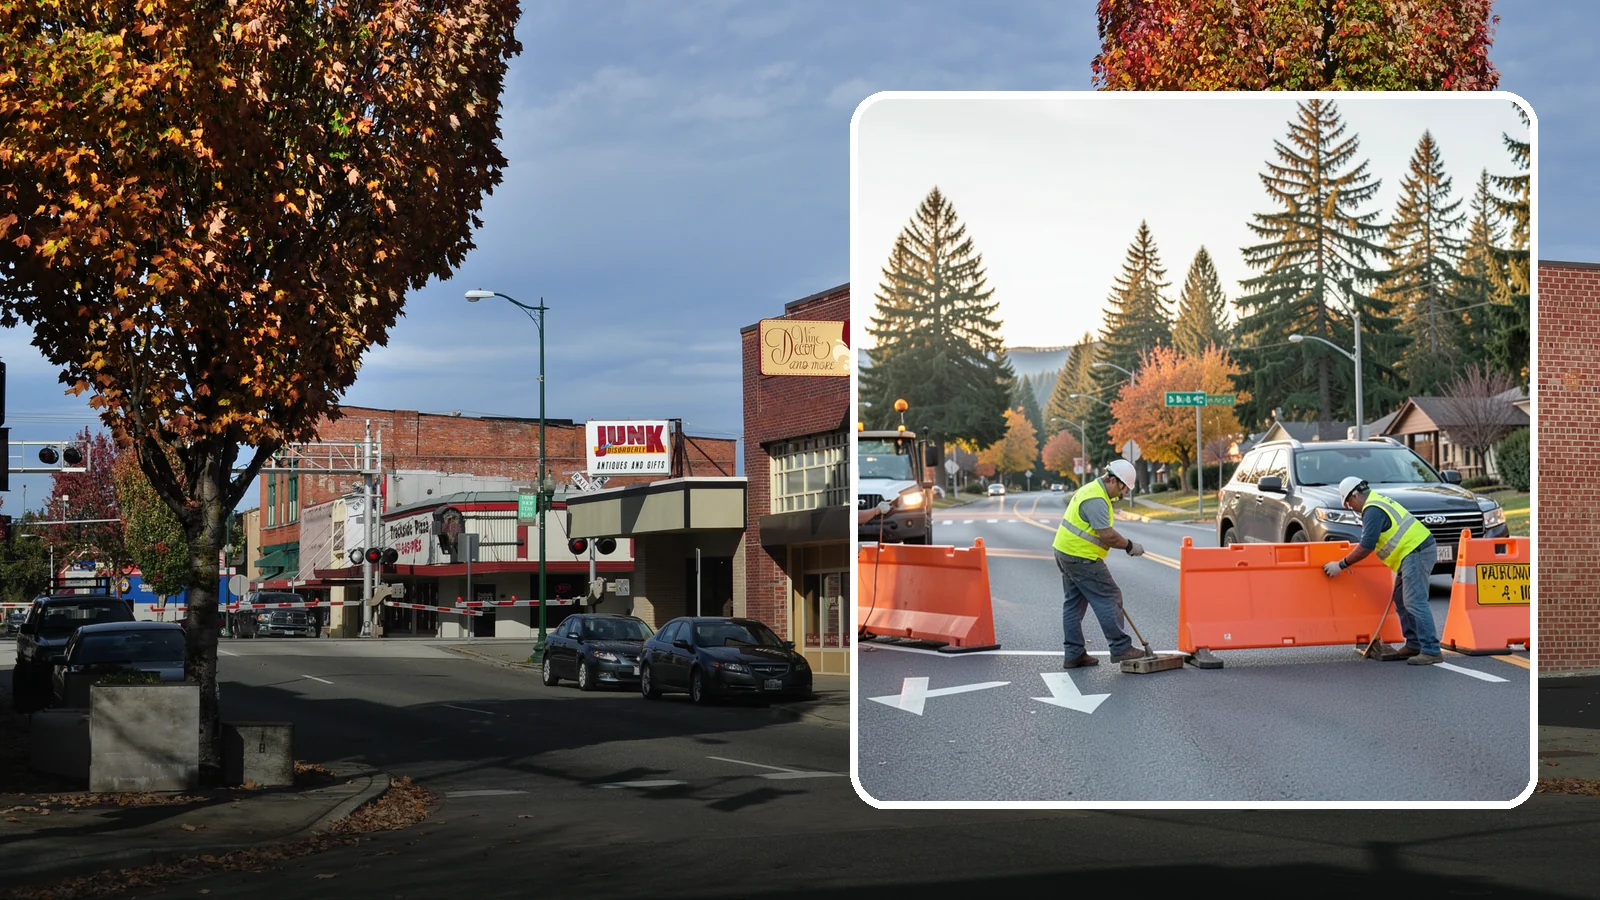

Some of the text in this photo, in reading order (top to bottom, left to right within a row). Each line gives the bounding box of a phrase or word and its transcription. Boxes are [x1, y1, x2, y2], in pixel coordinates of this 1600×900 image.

[765, 327, 831, 365] Decor
[595, 425, 665, 457] JUNK
[607, 446, 646, 454] DISORDERLY
[597, 460, 665, 470] ANTIQUES AND GIFTS
[414, 519, 429, 535] Pizza
